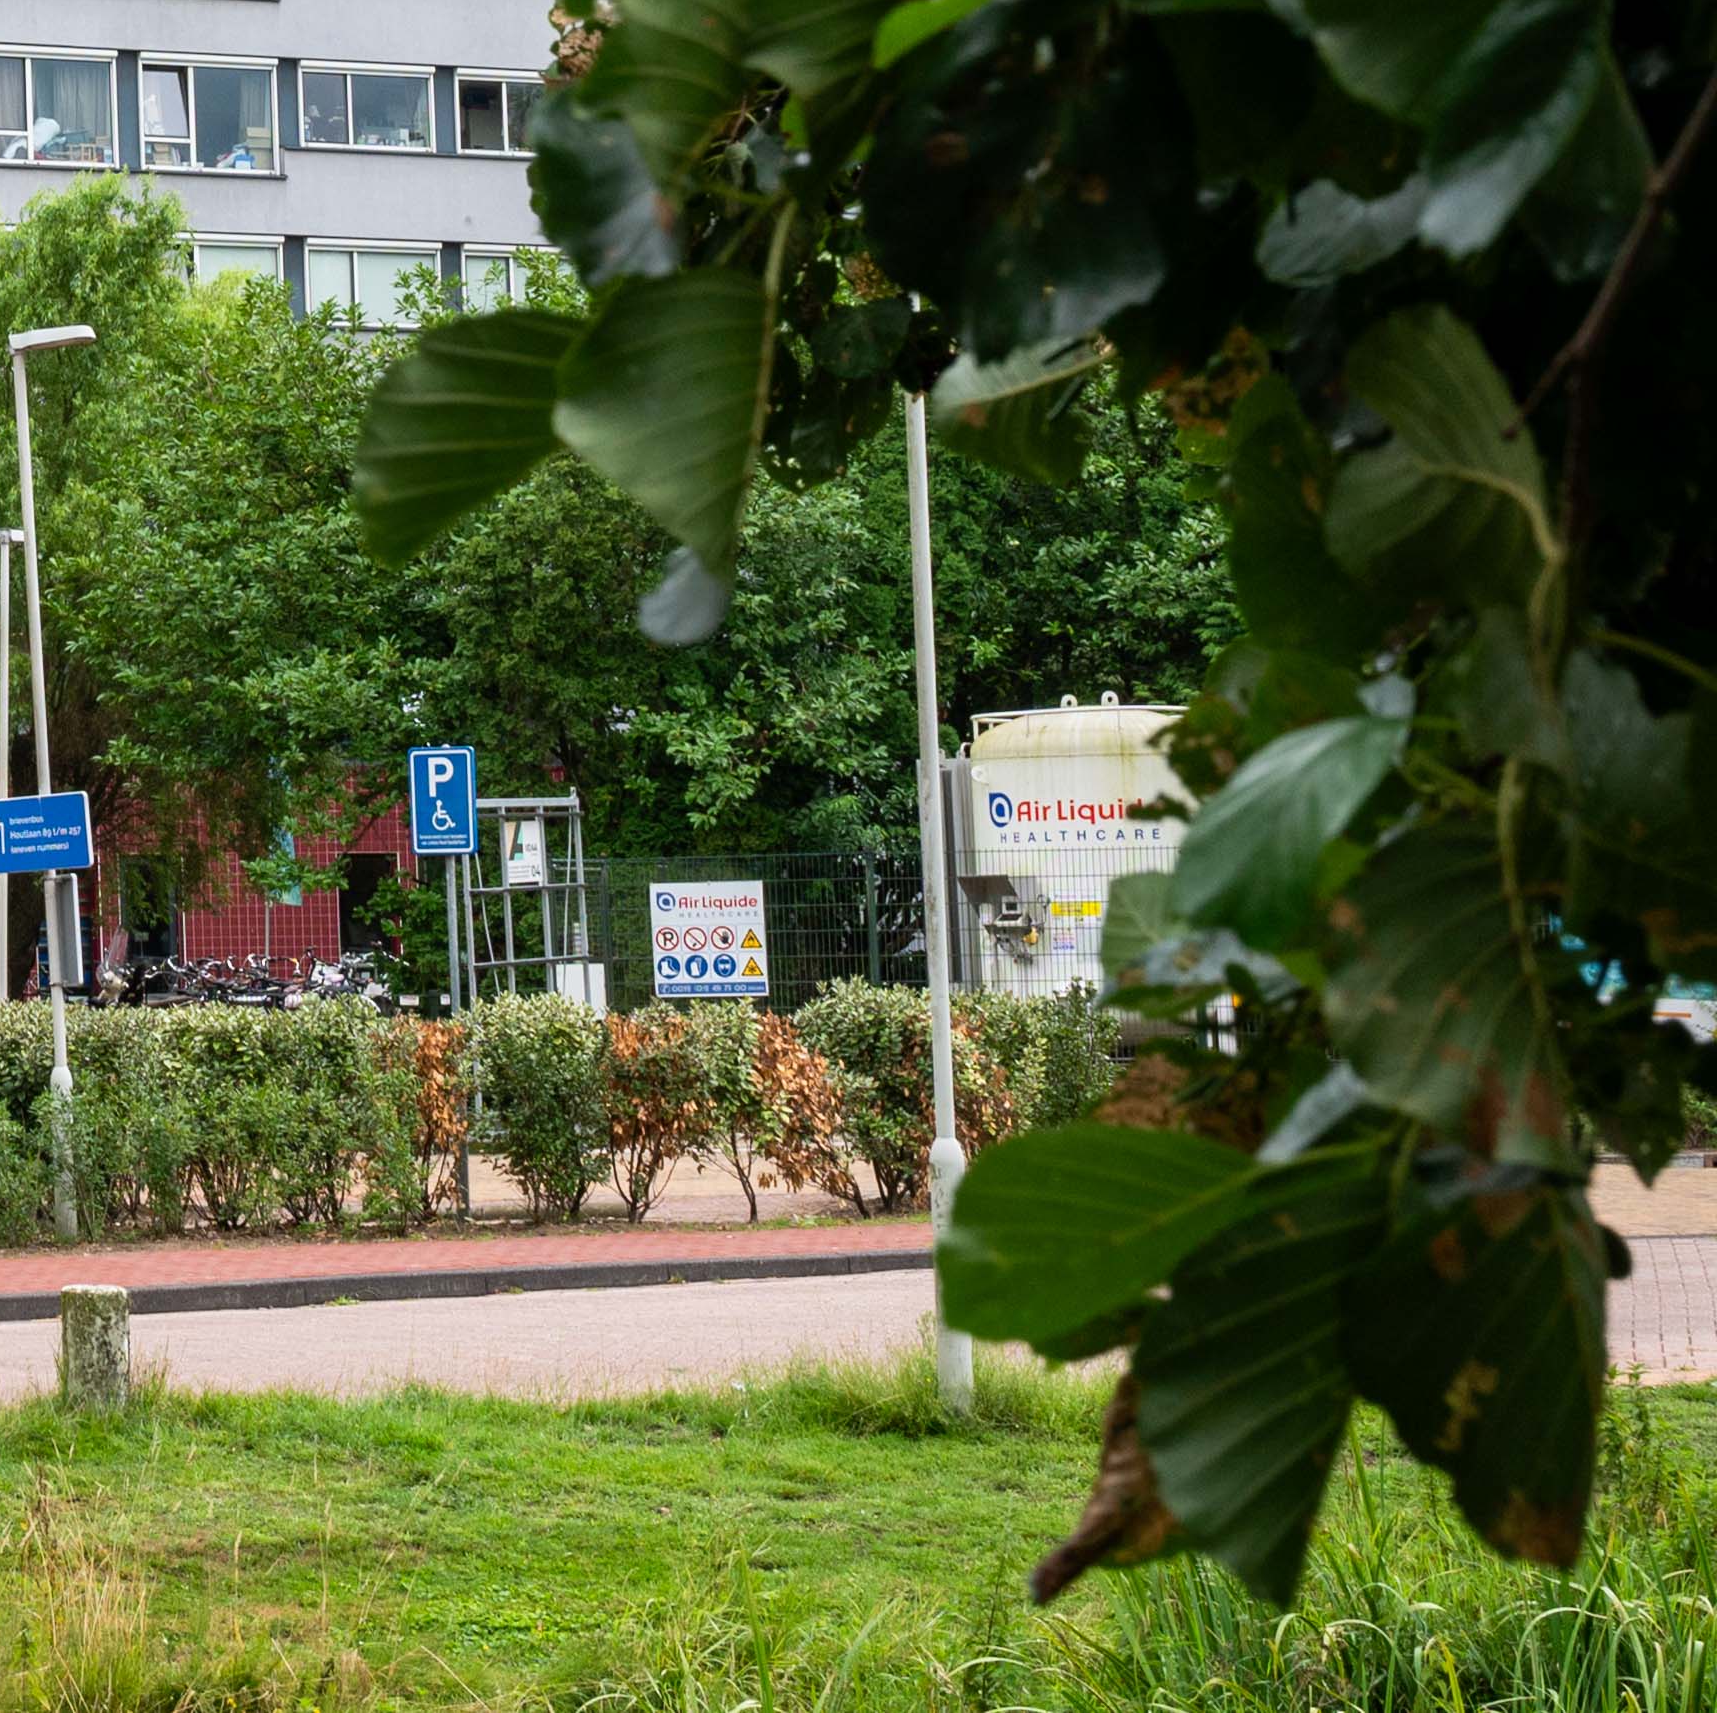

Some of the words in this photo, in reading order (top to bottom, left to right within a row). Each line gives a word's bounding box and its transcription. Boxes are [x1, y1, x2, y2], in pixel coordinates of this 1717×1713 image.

[428, 757, 454, 798] P
[1017, 800, 1052, 822] Air
[1057, 798, 1142, 825] Liqui
[9, 829, 42, 839] Houtlaan
[1000, 828, 1161, 844] HEALTHCARE
[678, 896, 698, 909] Air
[702, 895, 758, 910] Liquide
[679, 910, 758, 918] HEALTHCARE
